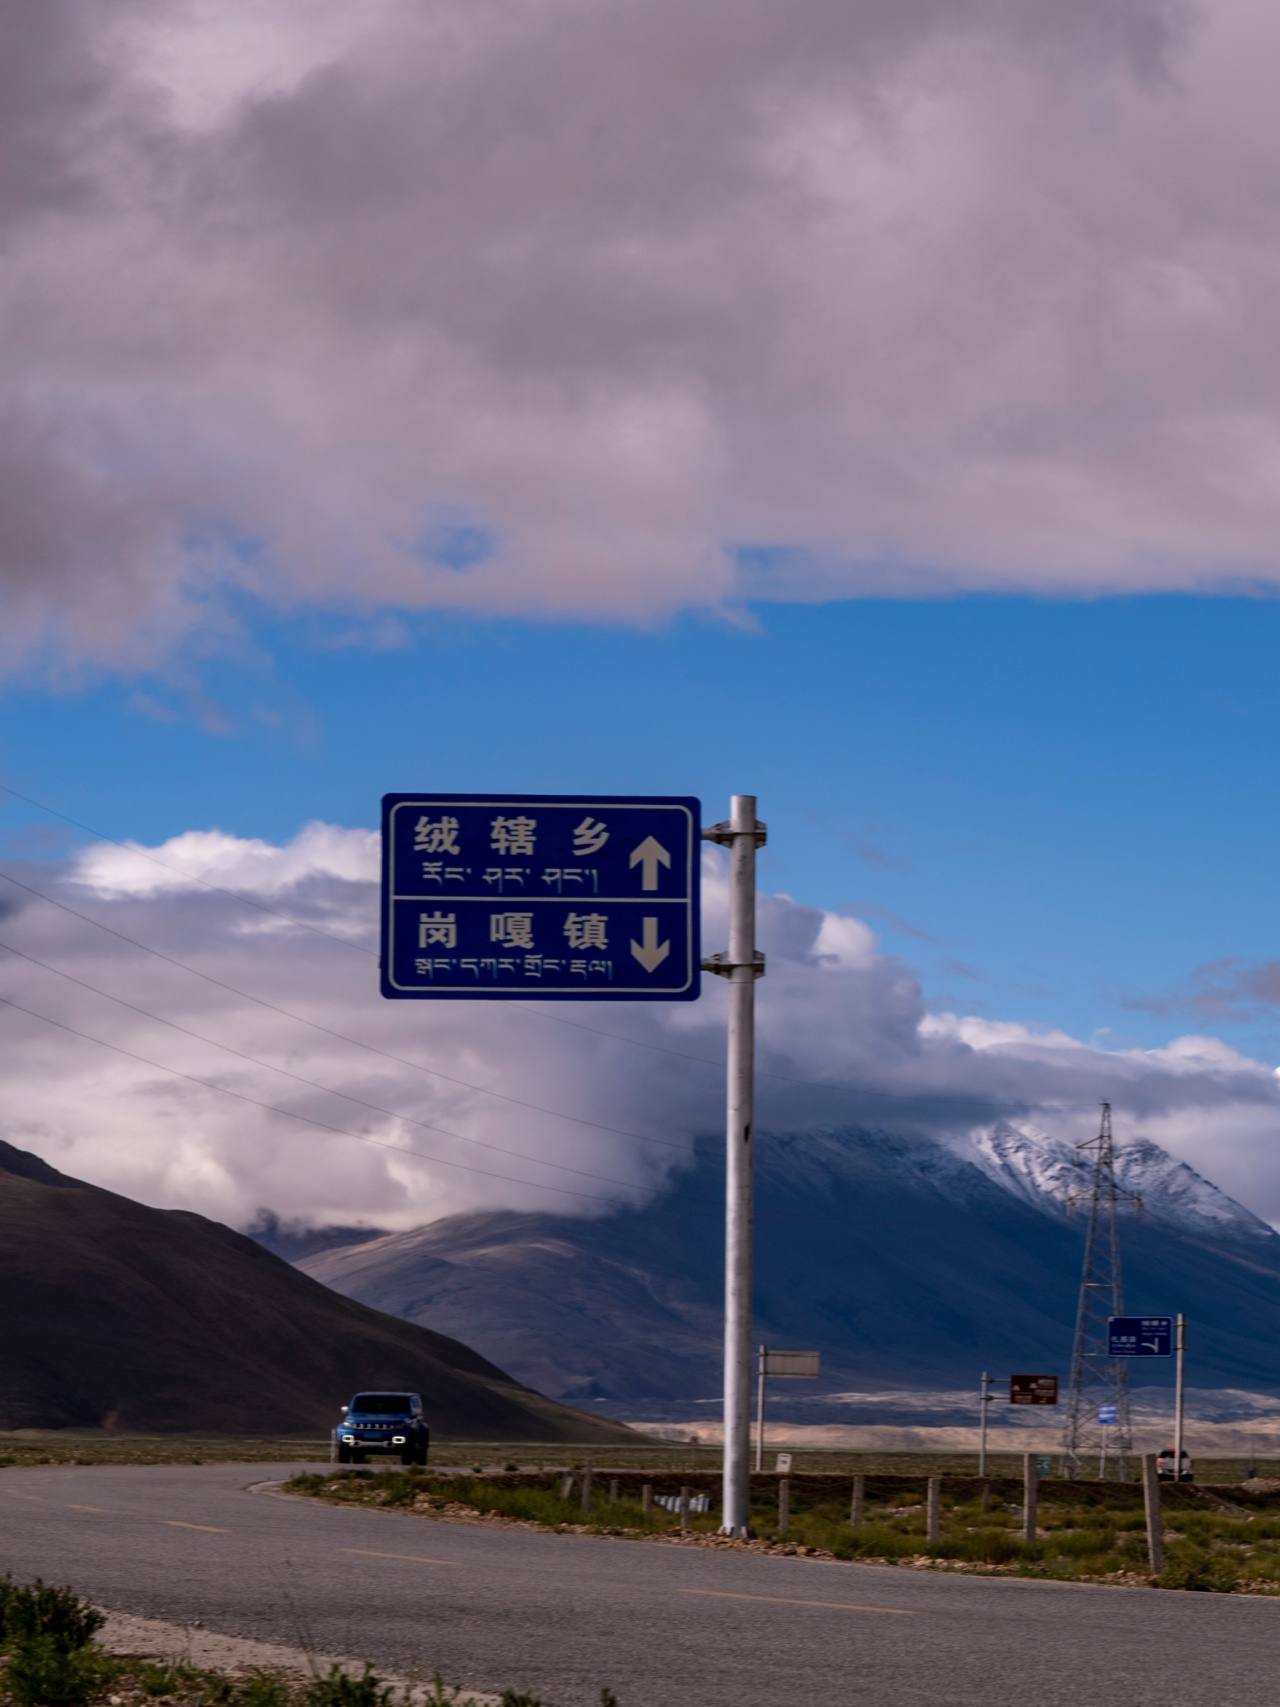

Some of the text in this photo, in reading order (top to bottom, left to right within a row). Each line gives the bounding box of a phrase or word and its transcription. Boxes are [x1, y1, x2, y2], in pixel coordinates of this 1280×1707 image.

[413, 815, 610, 856] 绒辖乡
[418, 910, 609, 950] 岗嘎镇
